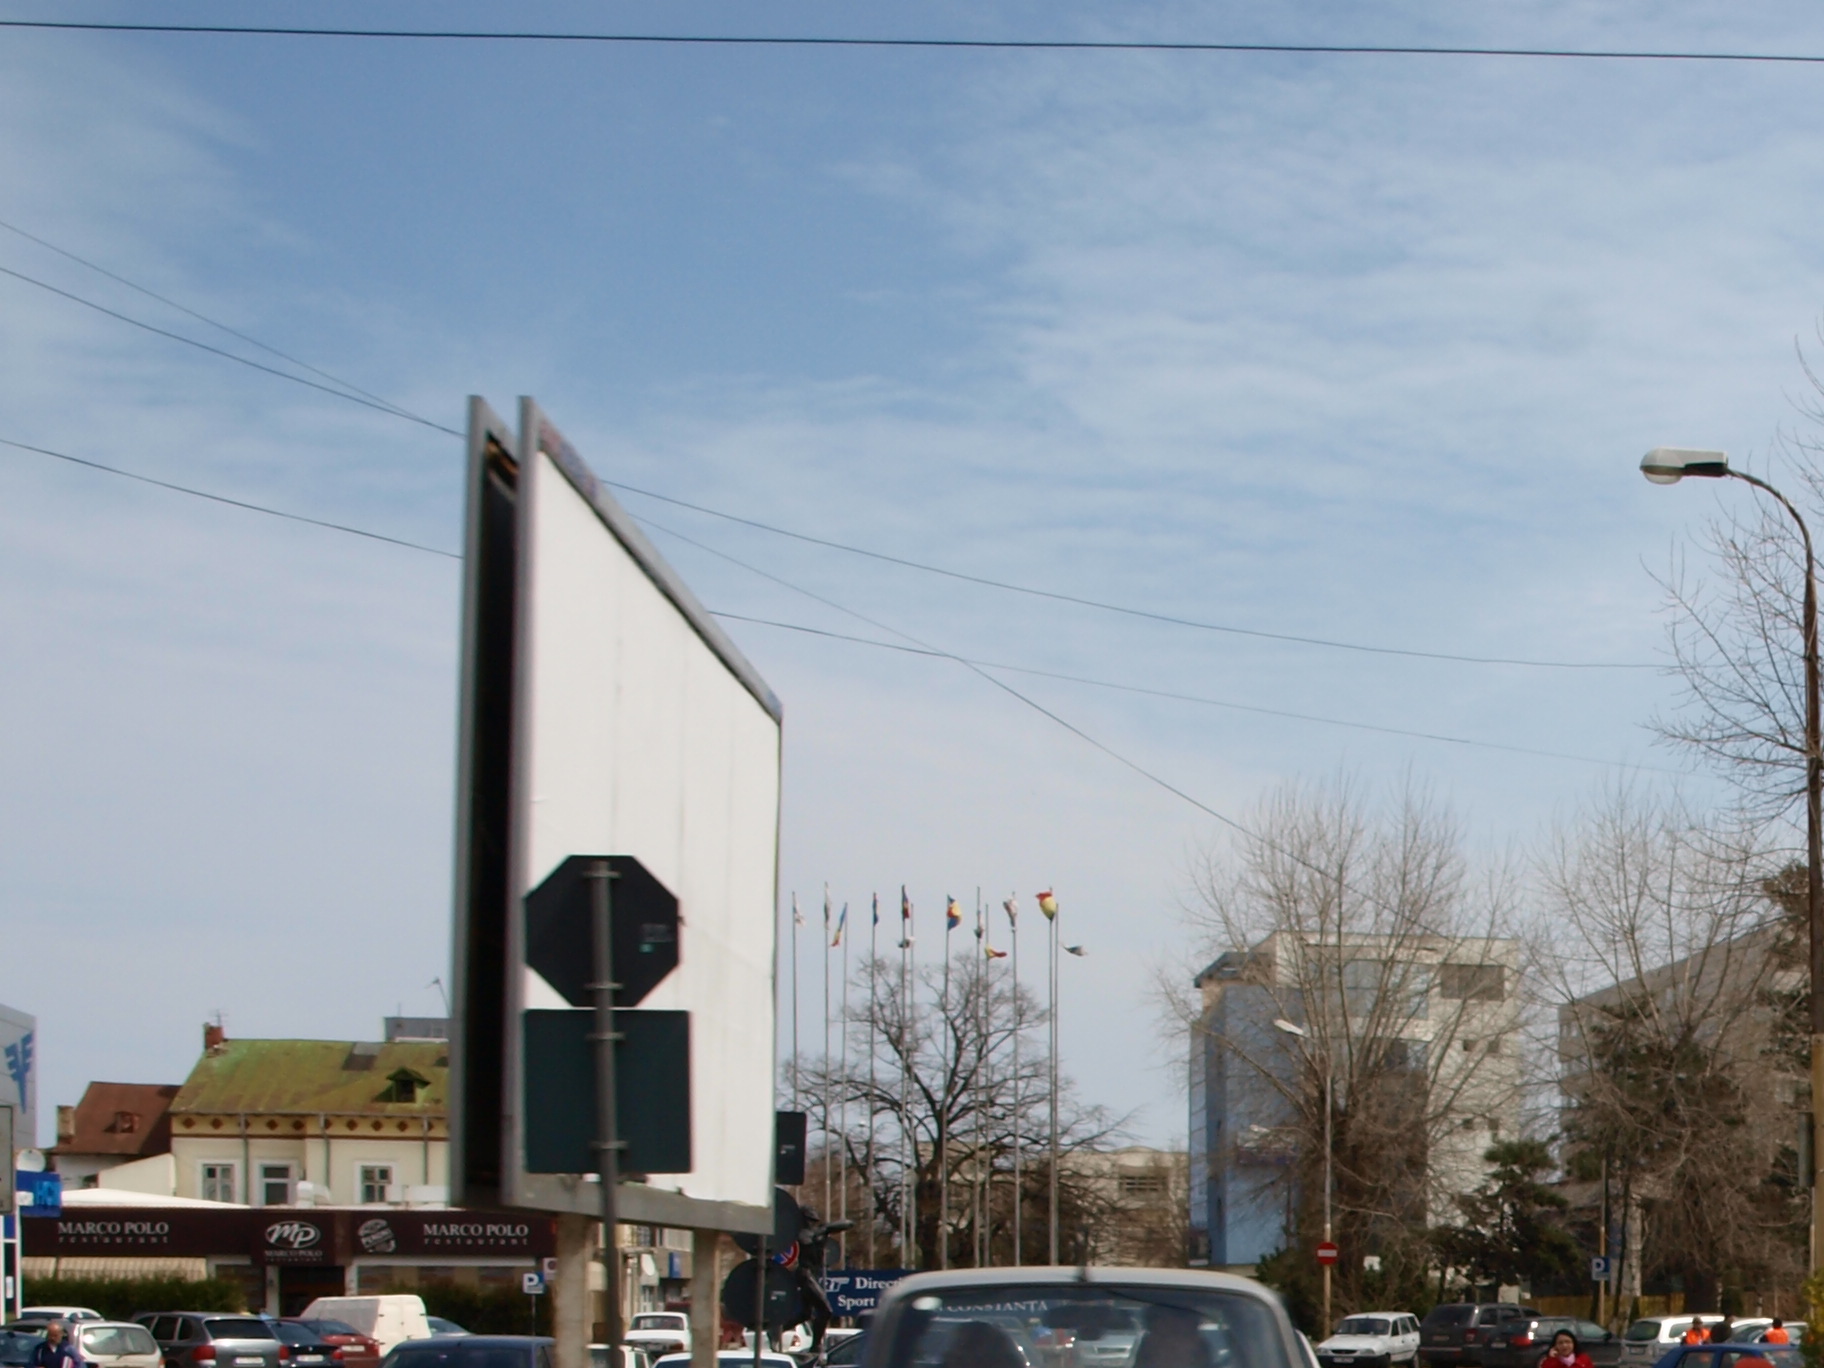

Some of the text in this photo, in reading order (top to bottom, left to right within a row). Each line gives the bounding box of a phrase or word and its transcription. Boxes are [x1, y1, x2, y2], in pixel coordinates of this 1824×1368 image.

[58, 1222, 170, 1234] MARCO POLO
[423, 1224, 529, 1236] MARCO POLO
[58, 1236, 169, 1244] restaurant
[837, 1294, 875, 1311] Sport
